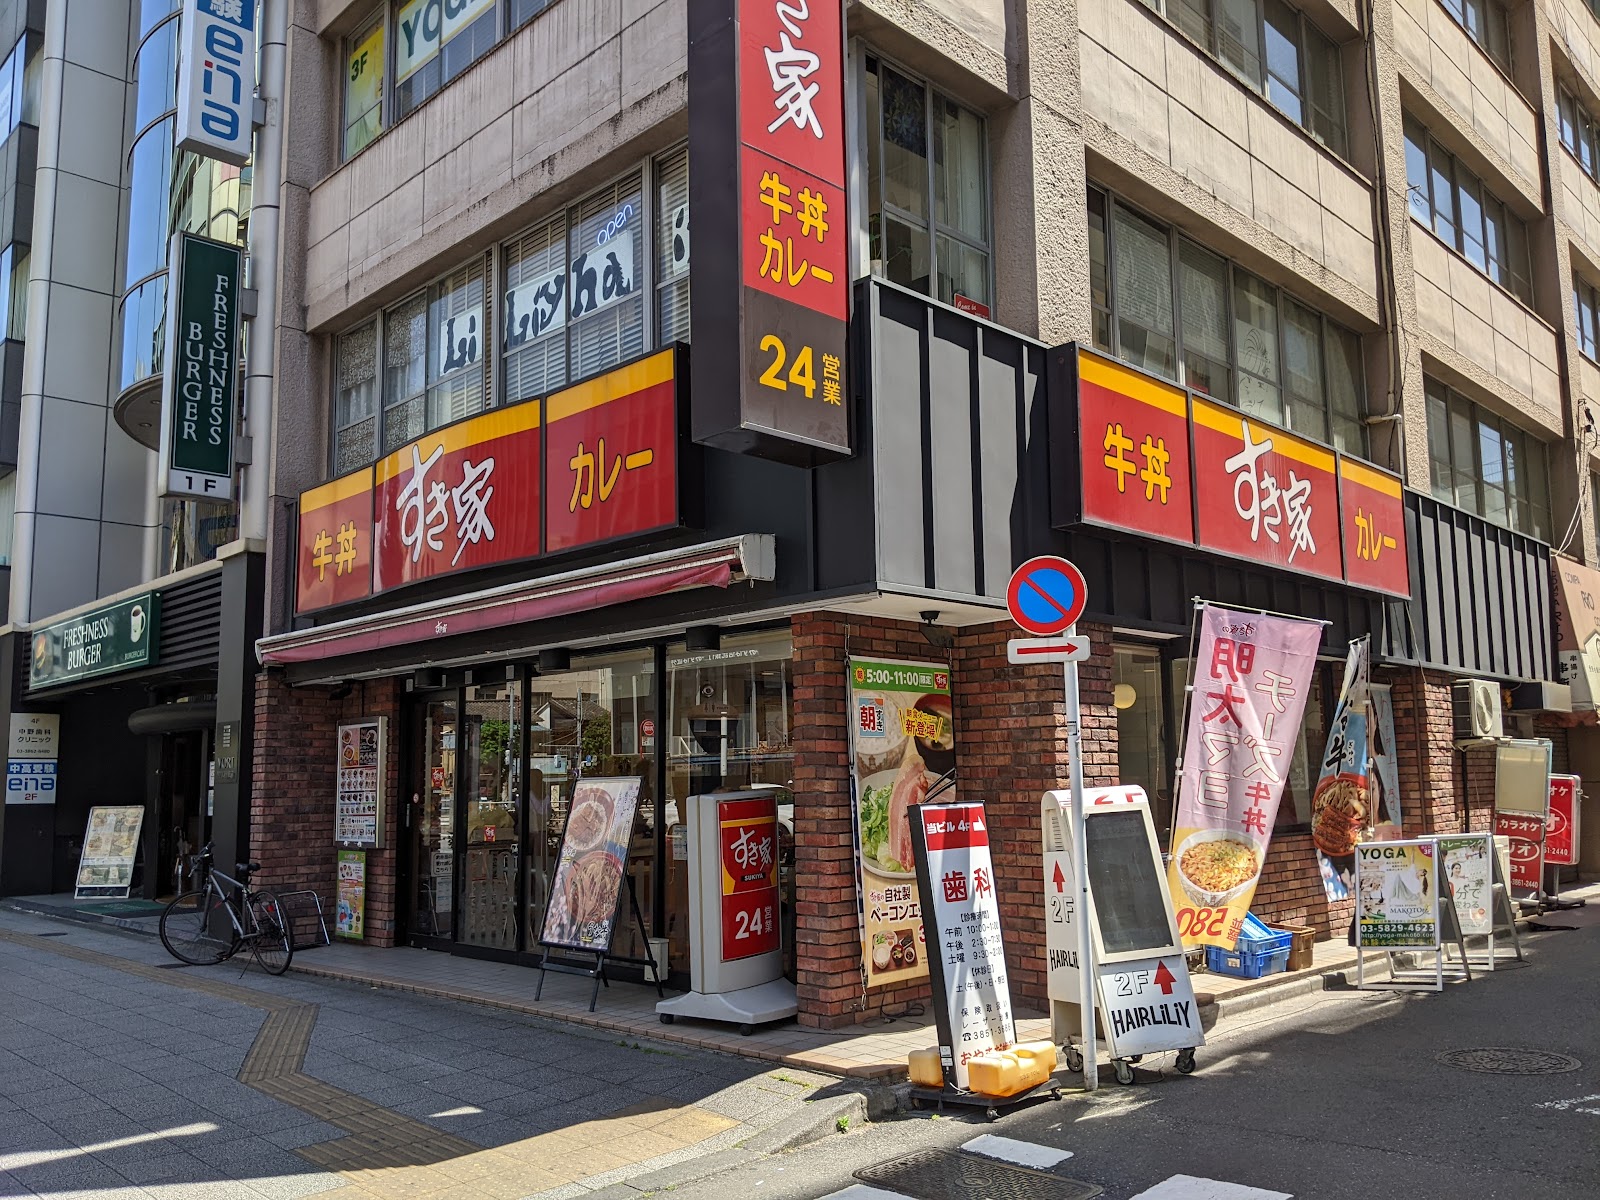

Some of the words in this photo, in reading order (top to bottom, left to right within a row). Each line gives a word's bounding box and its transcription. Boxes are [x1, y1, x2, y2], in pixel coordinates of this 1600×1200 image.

[351, 51, 368, 82] 3F
[759, 170, 829, 243] 牛丼
[597, 204, 633, 246] open
[759, 227, 834, 287] カレー
[208, 274, 230, 446] FRESHNESS
[759, 334, 816, 399] 24
[822, 352, 841, 406] 営業
[182, 321, 203, 442] BURGER
[568, 437, 654, 513] カレー
[1103, 422, 1172, 505] 牛丼
[185, 475, 217, 493] 1F
[1224, 417, 1317, 564] すき家
[396, 443, 495, 566] すき家
[1354, 507, 1397, 561] カレー
[312, 520, 358, 582] 牛丼
[63, 616, 109, 649] FRESHNESS
[67, 643, 102, 671] BURGER
[866, 669, 919, 686] 5:00-11:00
[860, 706, 876, 731] 朝
[905, 718, 936, 738] 新登場
[8, 777, 55, 791] ena
[24, 793, 38, 801] 2F
[1550, 786, 1568, 797] オケ
[927, 821, 955, 834] 当ビル
[958, 820, 970, 832] 4F
[1499, 819, 1540, 832] カラオケ
[1546, 813, 1560, 832] オ
[730, 827, 772, 871] すき家
[1360, 847, 1406, 860] YOGA
[1441, 839, 1485, 848] トレーニング
[744, 872, 764, 882] SUKIYA
[942, 867, 992, 903] 歯科
[885, 886, 911, 903] 自社製
[735, 908, 763, 940] 24
[764, 905, 773, 934] 営業
[1050, 896, 1075, 923] 2F
[945, 927, 963, 938] 午前
[1361, 923, 1435, 933] 03-5829-4623
[946, 940, 964, 951] 午後
[1049, 948, 1080, 972] HAIRLiL
[1114, 969, 1149, 997] 2F
